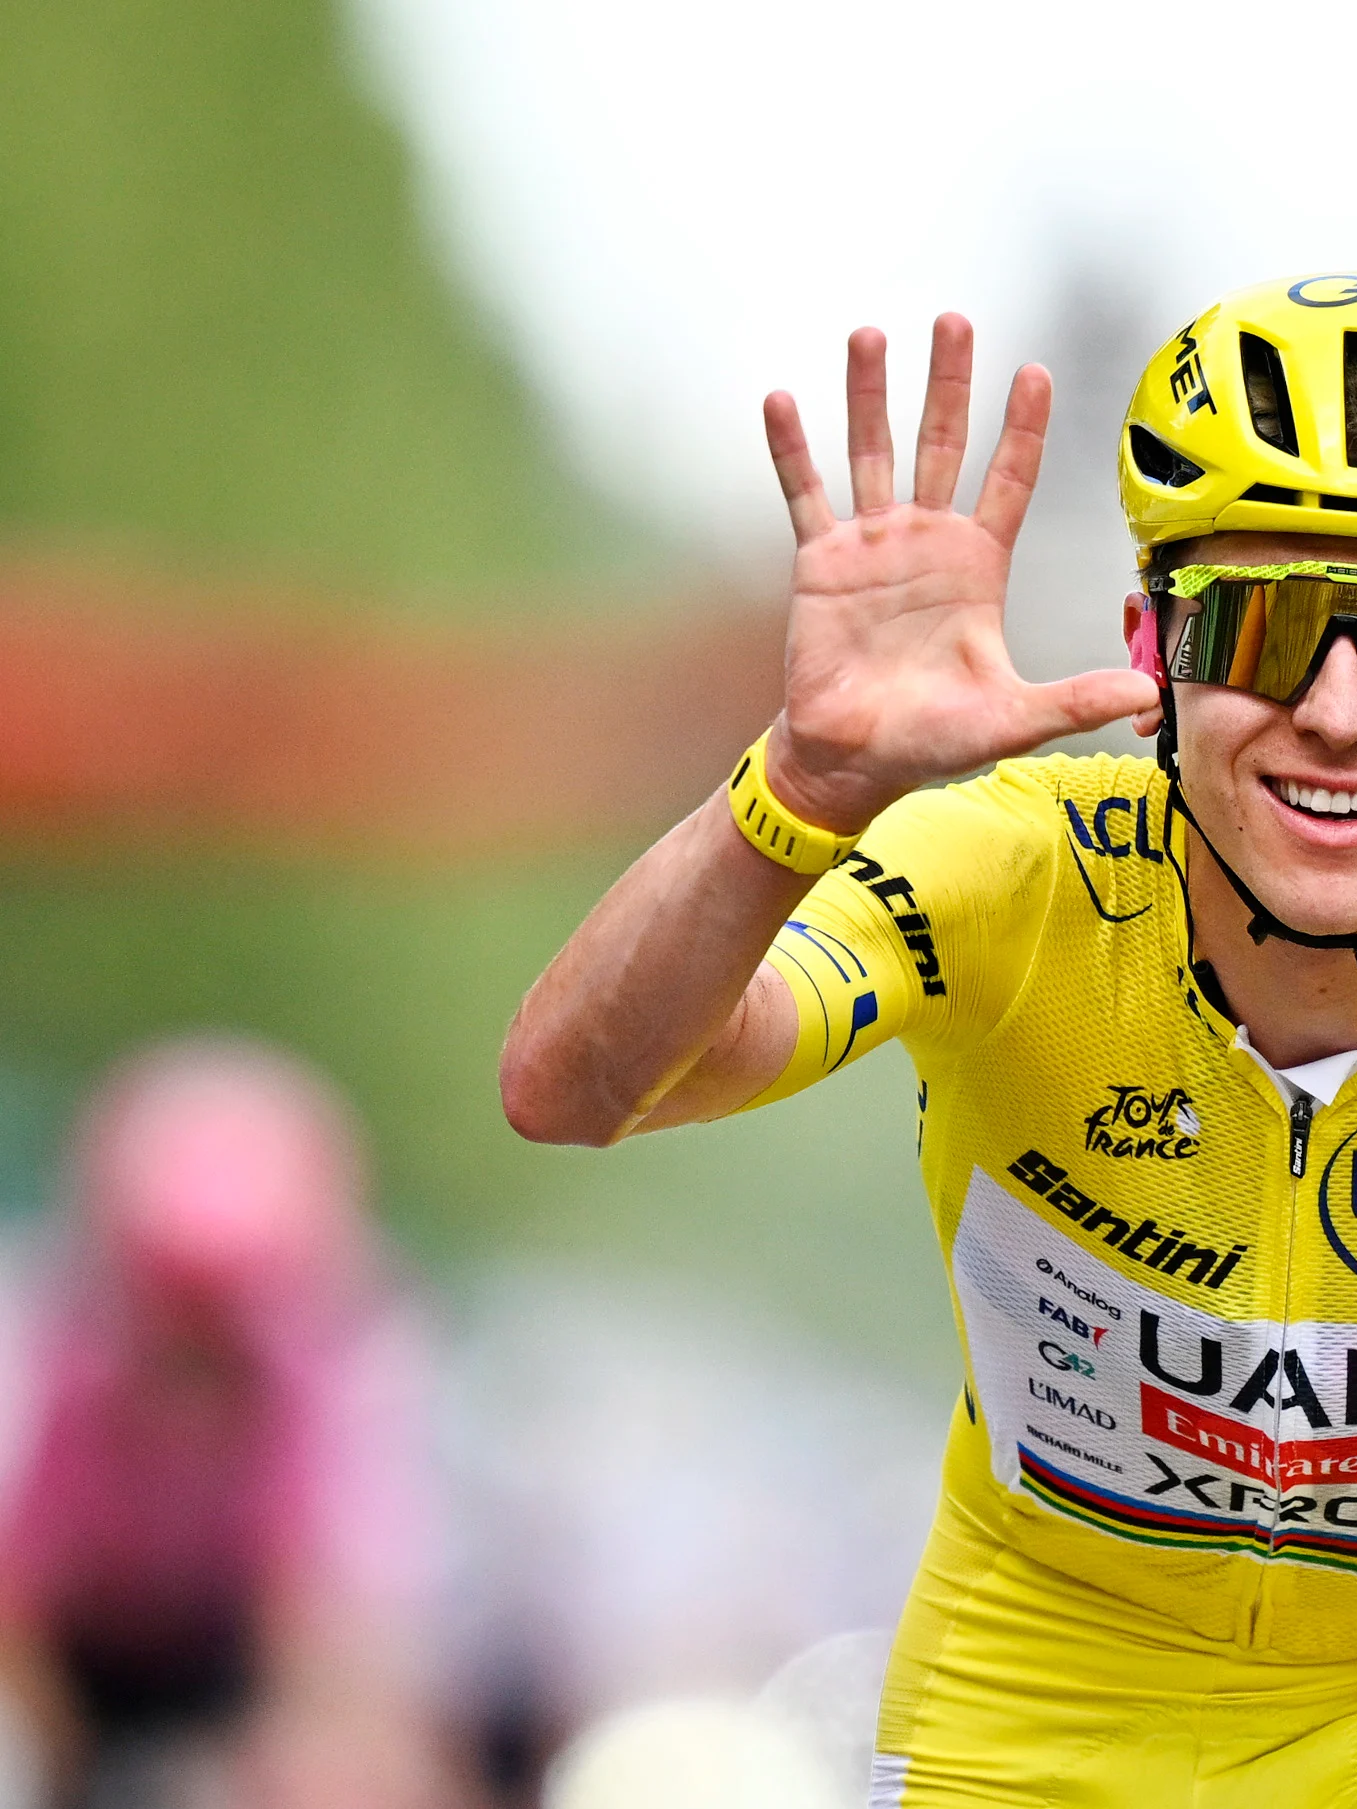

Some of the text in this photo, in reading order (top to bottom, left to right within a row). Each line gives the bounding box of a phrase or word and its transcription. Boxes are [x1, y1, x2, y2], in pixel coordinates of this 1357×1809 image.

[1170, 318, 1217, 415] MET
[1064, 796, 1164, 865] LCL
[834, 849, 946, 996] ntini
[1158, 1119, 1175, 1136] de
[1006, 1149, 1248, 1289] Santini
[1053, 1267, 1122, 1321] Analog
[1027, 1424, 1123, 1475] RICHARD MILLE
